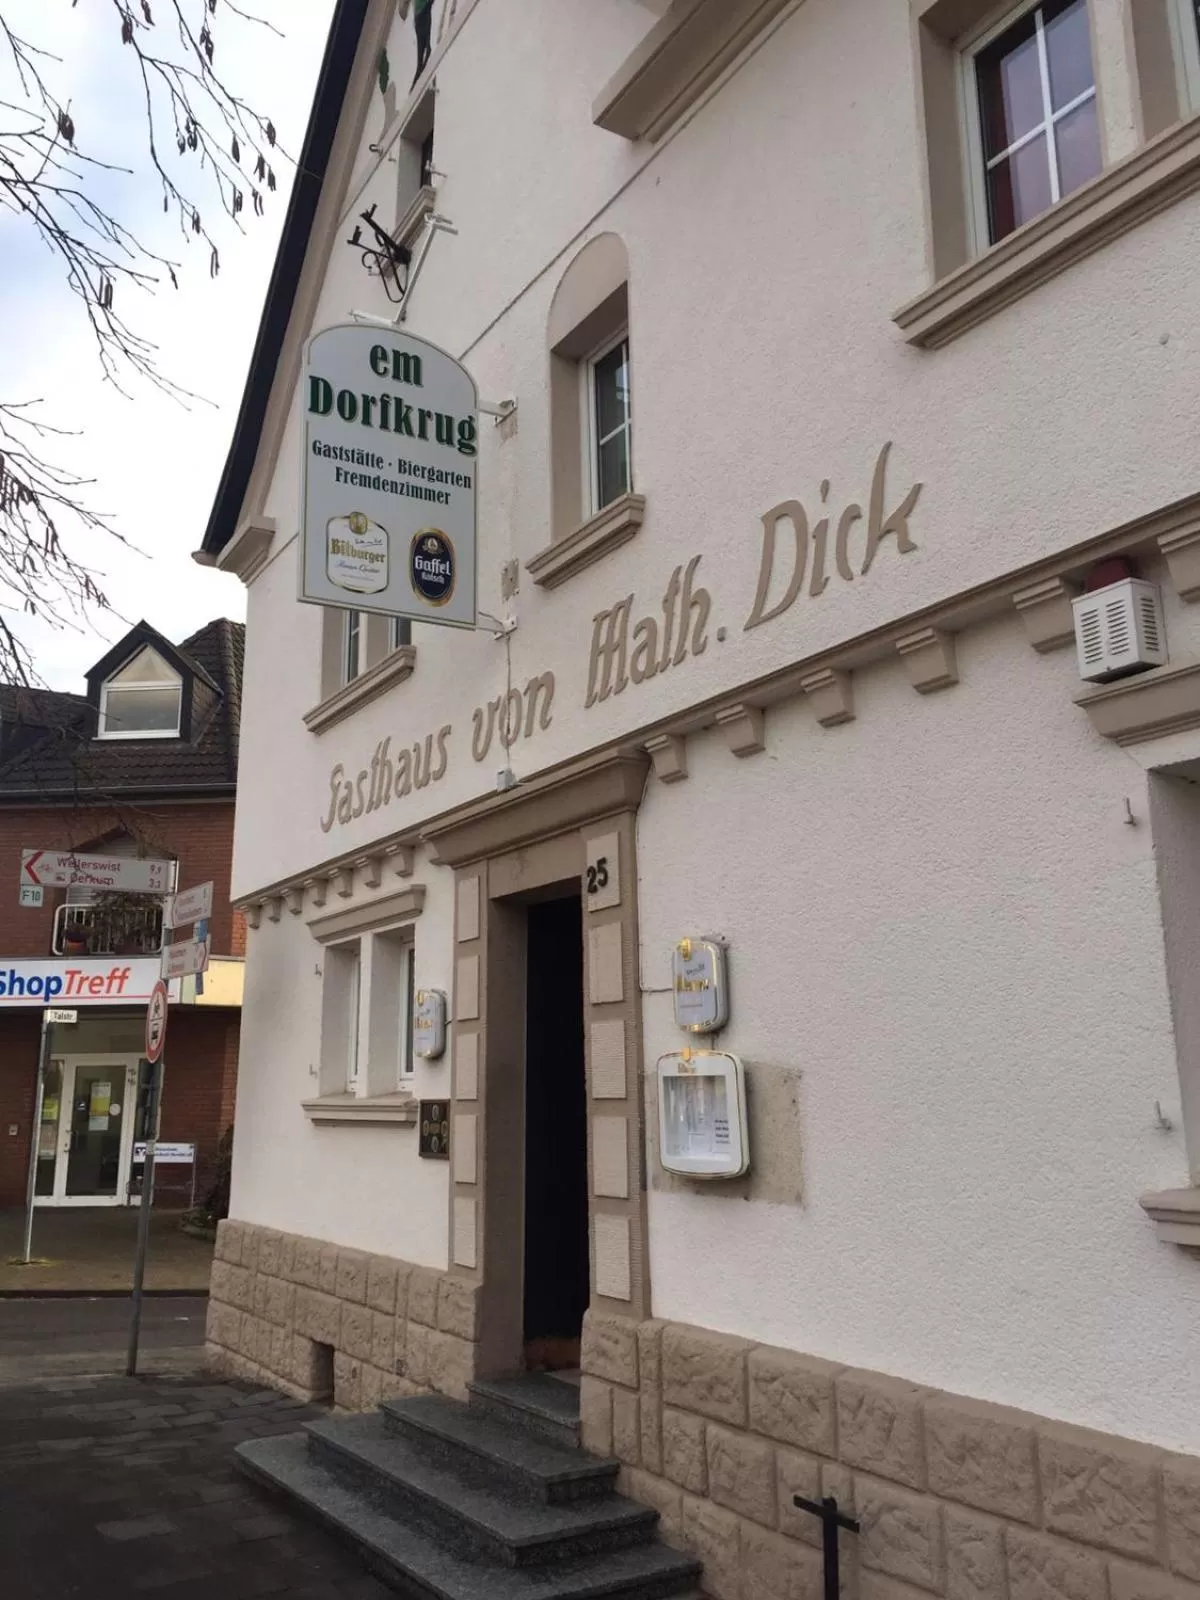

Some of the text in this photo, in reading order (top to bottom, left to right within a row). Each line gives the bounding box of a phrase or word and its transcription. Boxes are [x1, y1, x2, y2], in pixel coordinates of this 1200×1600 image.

[369, 343, 424, 388] em
[308, 374, 478, 457] Dorfkrug
[311, 439, 472, 489] Gaststätte Biergarten
[335, 466, 451, 505] Fremdenzimmer
[414, 555, 451, 576] Gaffel
[471, 670, 556, 763] von
[742, 441, 924, 632] Dick
[587, 857, 609, 893] 25
